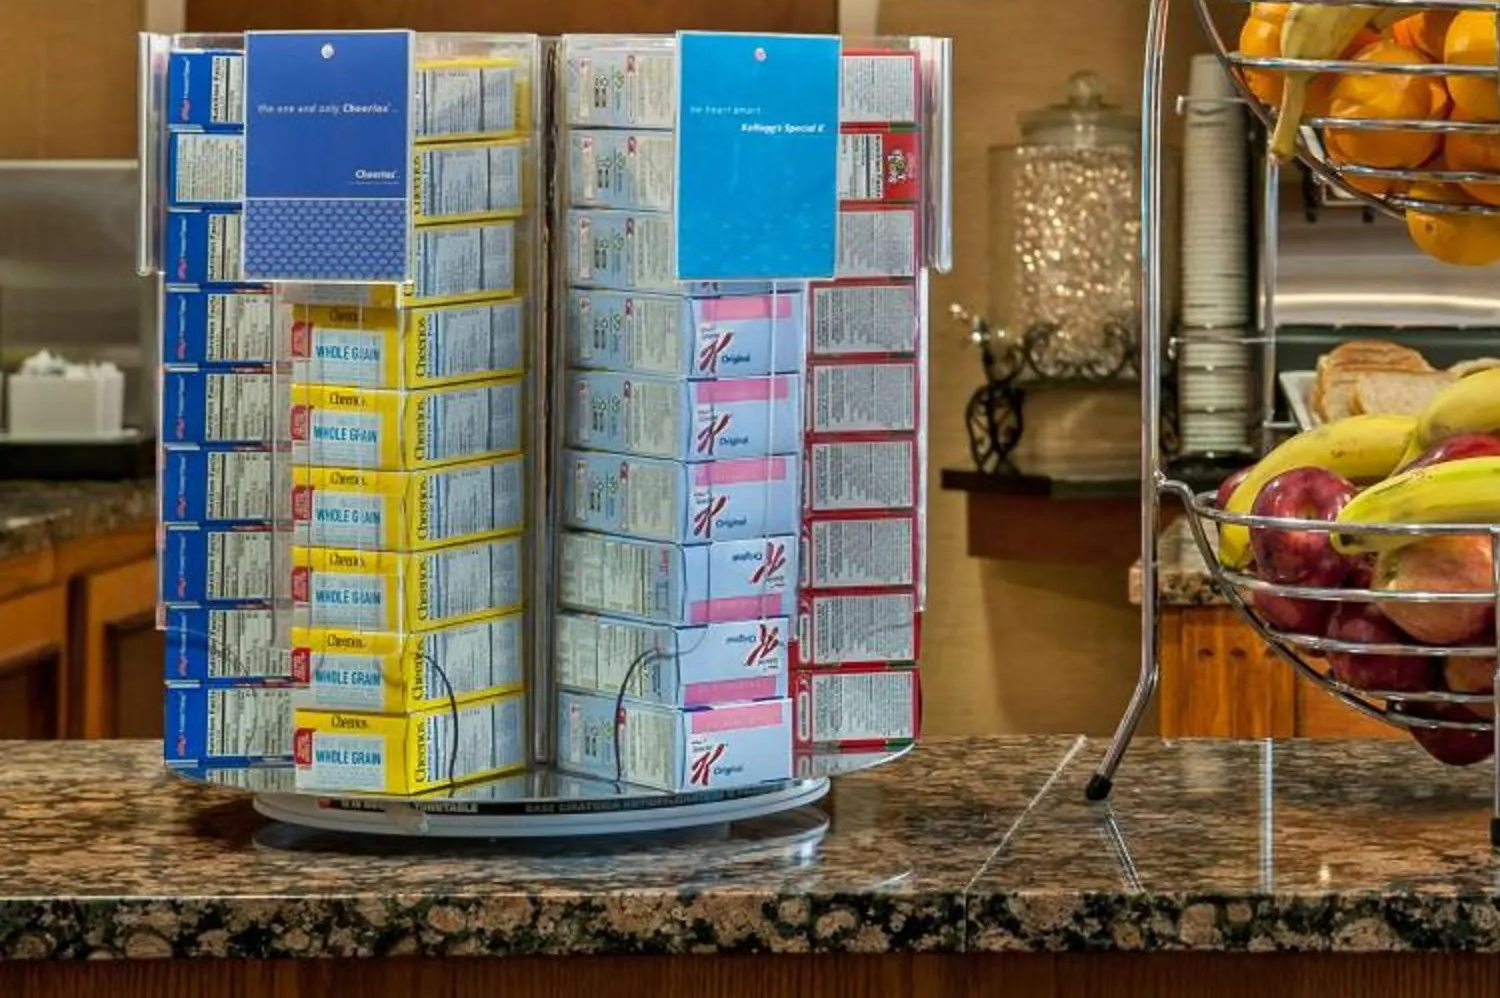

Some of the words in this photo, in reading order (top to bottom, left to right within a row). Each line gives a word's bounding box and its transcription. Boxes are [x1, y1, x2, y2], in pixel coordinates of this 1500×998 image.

[343, 103, 389, 114] Cheerios
[784, 122, 817, 134] Special
[355, 169, 396, 180] Cheerios
[316, 345, 350, 361] WHOLE
[316, 508, 351, 523] WHOLE
[315, 589, 351, 605] WHOLE
[315, 669, 350, 686] WHOLE
[350, 671, 380, 687] GRAIN
[315, 749, 350, 765] WHOLE
[351, 750, 381, 766] GRAIN
